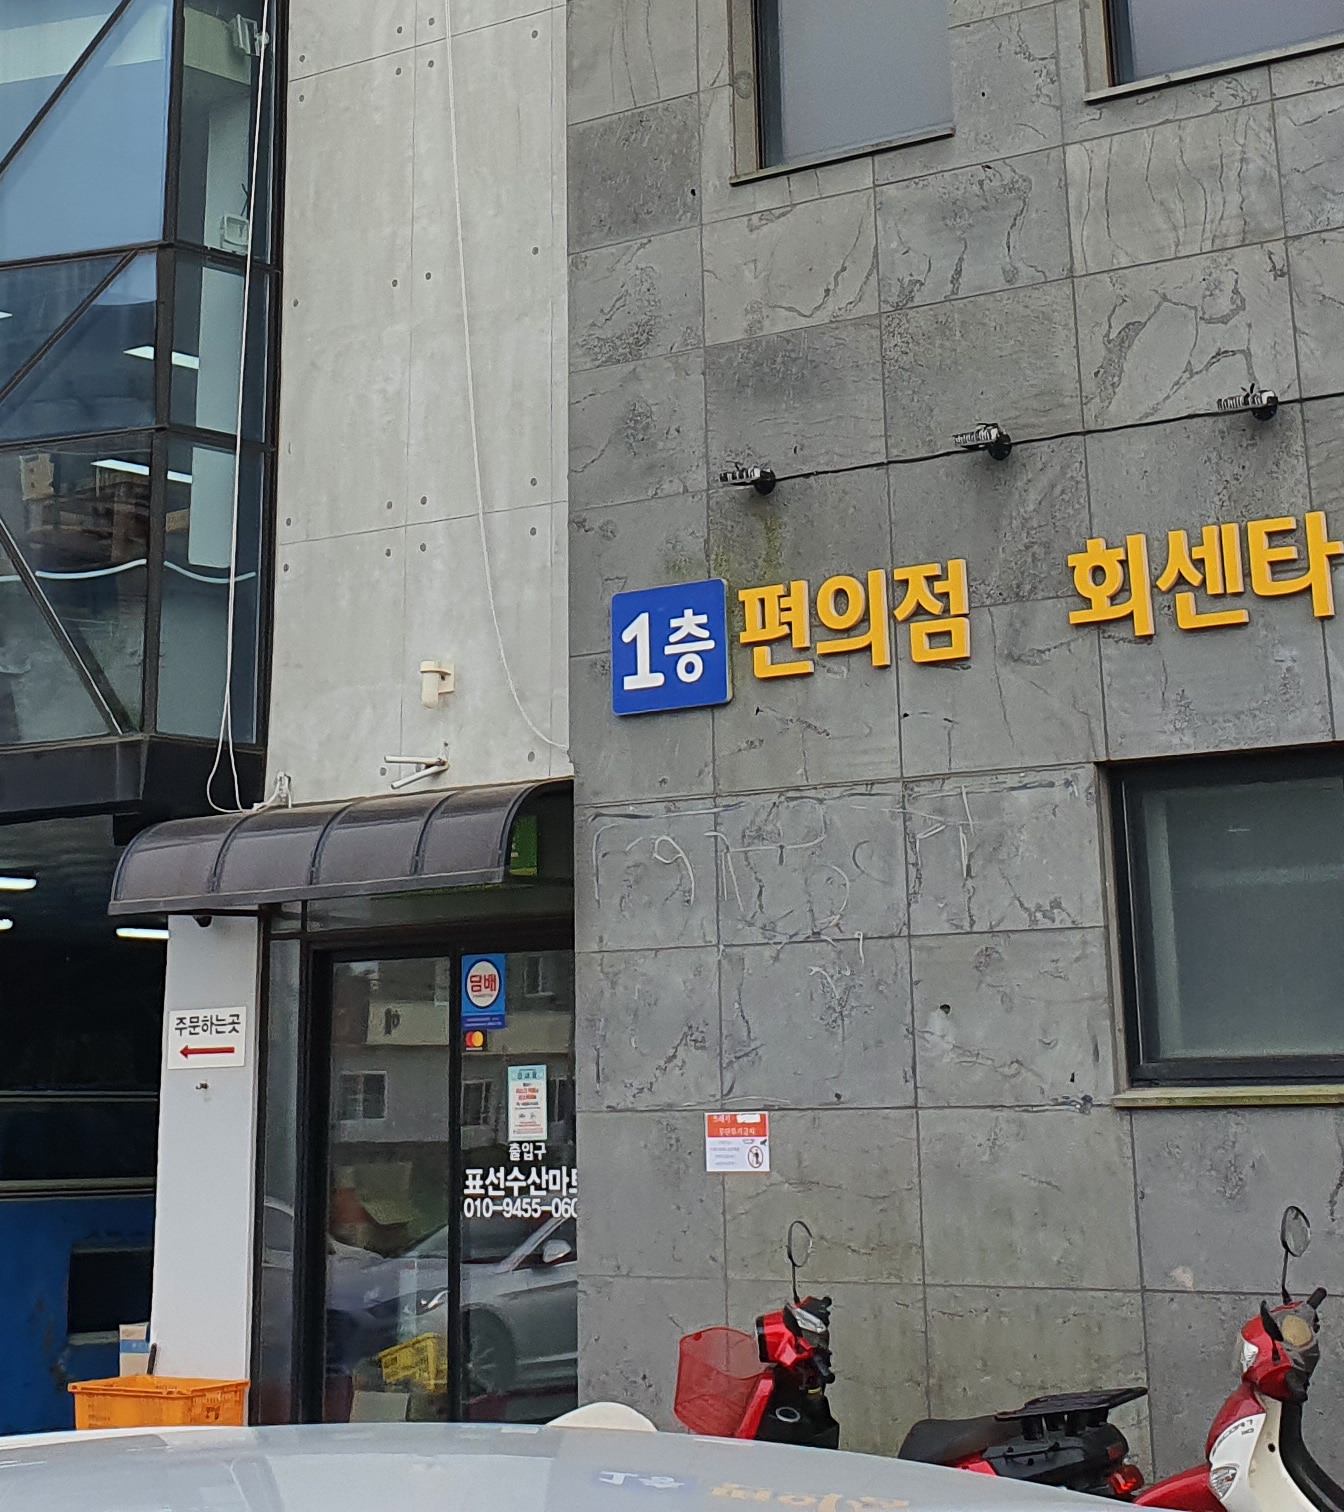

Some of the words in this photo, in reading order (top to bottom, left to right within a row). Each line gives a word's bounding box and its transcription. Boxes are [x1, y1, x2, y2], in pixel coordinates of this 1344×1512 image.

[620, 607, 716, 691] 1층
[738, 558, 971, 679] 편의점
[174, 1013, 242, 1037] 주문하는곳
[509, 1142, 547, 1161] 출입구
